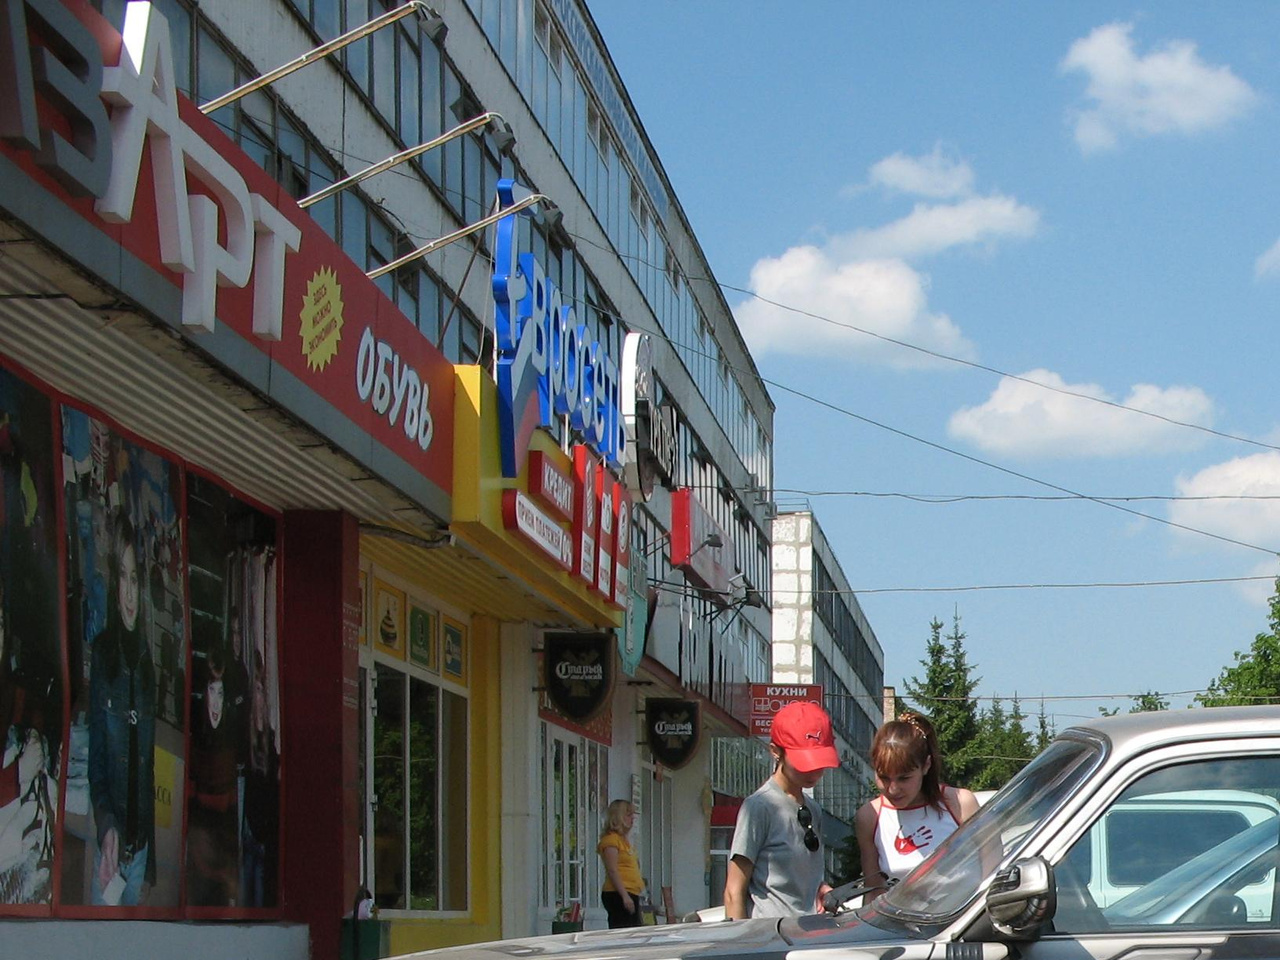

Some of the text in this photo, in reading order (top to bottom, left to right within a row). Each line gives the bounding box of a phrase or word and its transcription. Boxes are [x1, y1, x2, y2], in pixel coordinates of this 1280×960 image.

[356, 326, 434, 451] ОБУВЬ
[544, 462, 572, 512] КРЕДИТ
[766, 687, 807, 696] КУХНИ
